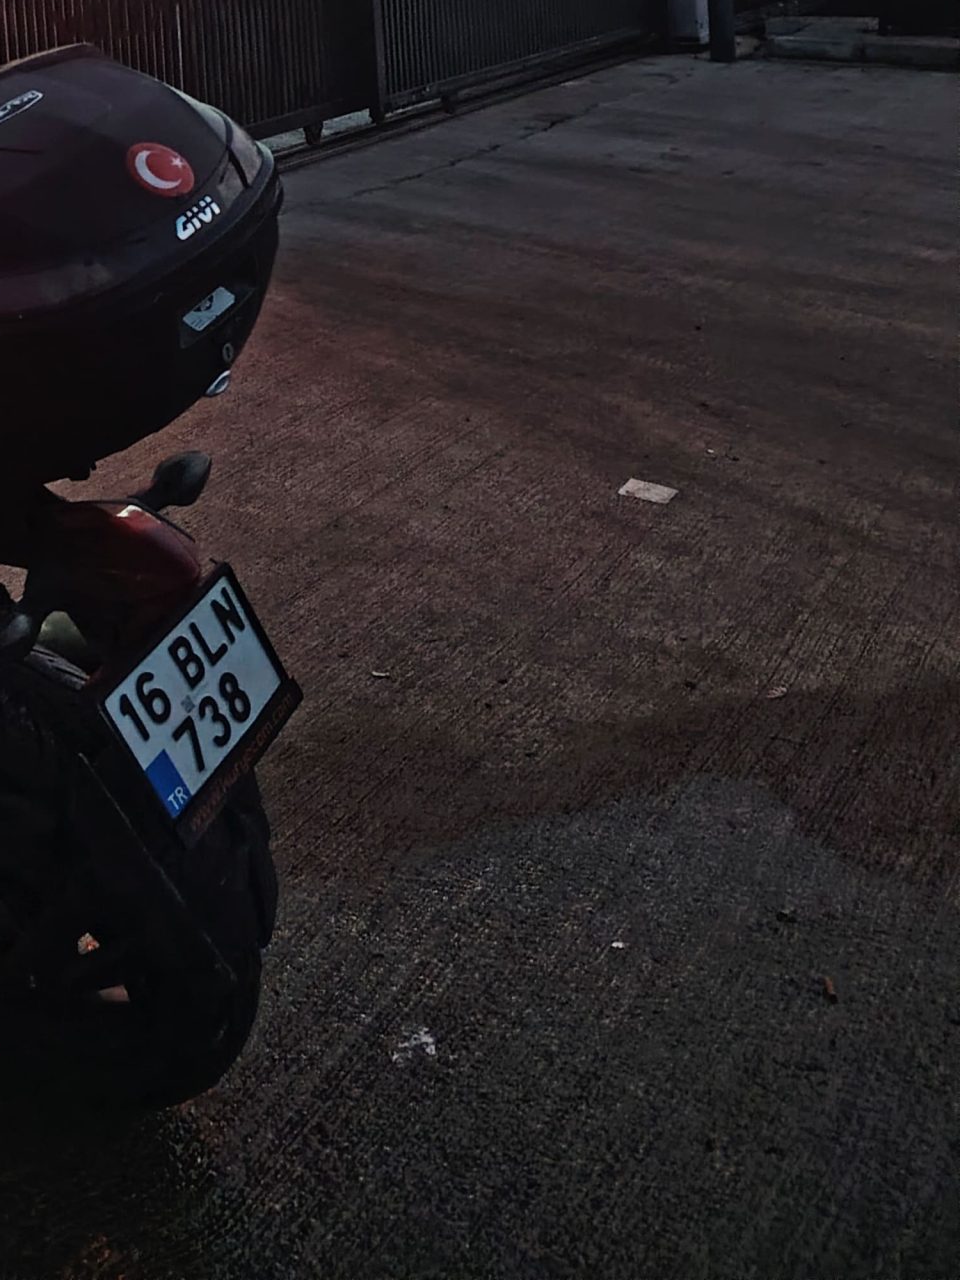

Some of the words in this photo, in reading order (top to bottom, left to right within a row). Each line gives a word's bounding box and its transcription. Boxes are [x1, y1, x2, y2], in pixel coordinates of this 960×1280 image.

[119, 671, 172, 742] 16
[167, 586, 246, 689] BLN
[171, 672, 252, 773] 738
[166, 785, 189, 811] TR
